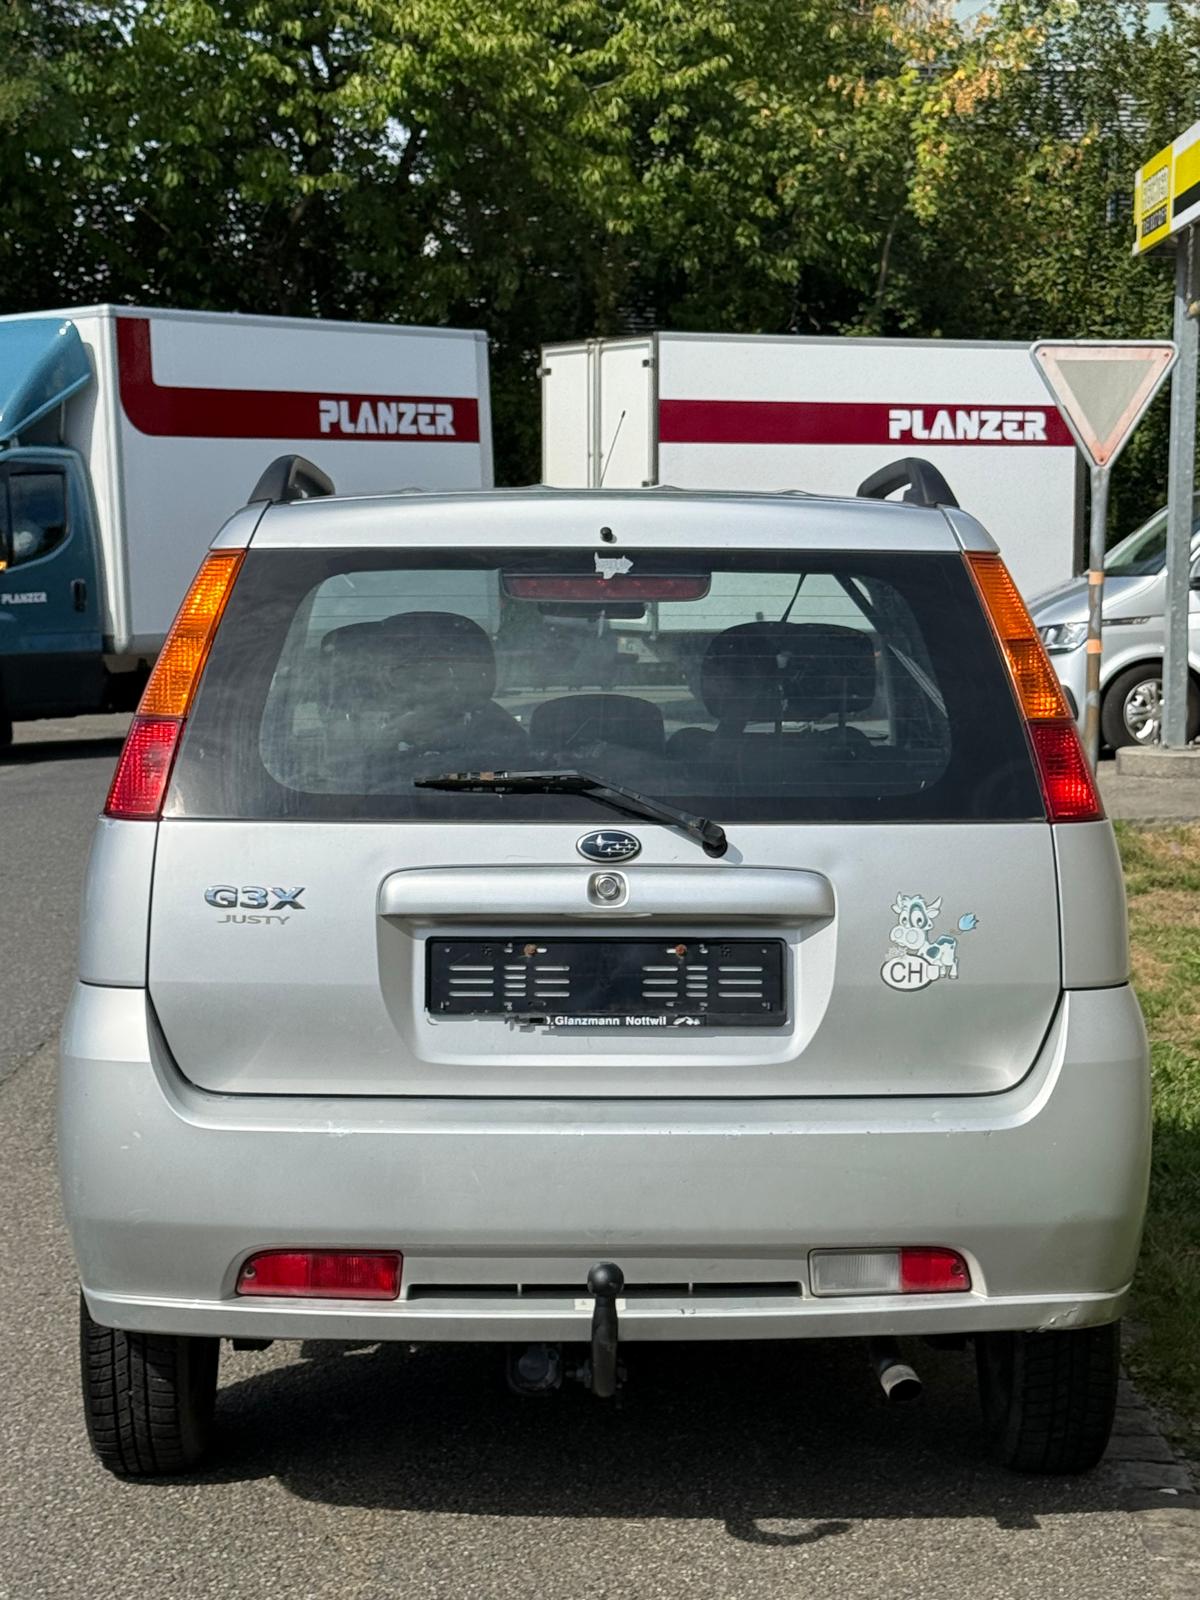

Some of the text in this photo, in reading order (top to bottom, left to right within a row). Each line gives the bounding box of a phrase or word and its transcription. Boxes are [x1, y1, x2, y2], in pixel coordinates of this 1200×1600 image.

[318, 400, 456, 436] PLANZER
[888, 409, 1048, 441] PLANZER
[204, 885, 306, 910] G3X
[217, 914, 290, 925] JUSTY
[890, 962, 923, 983] CH
[625, 1016, 667, 1026] Nottwil
